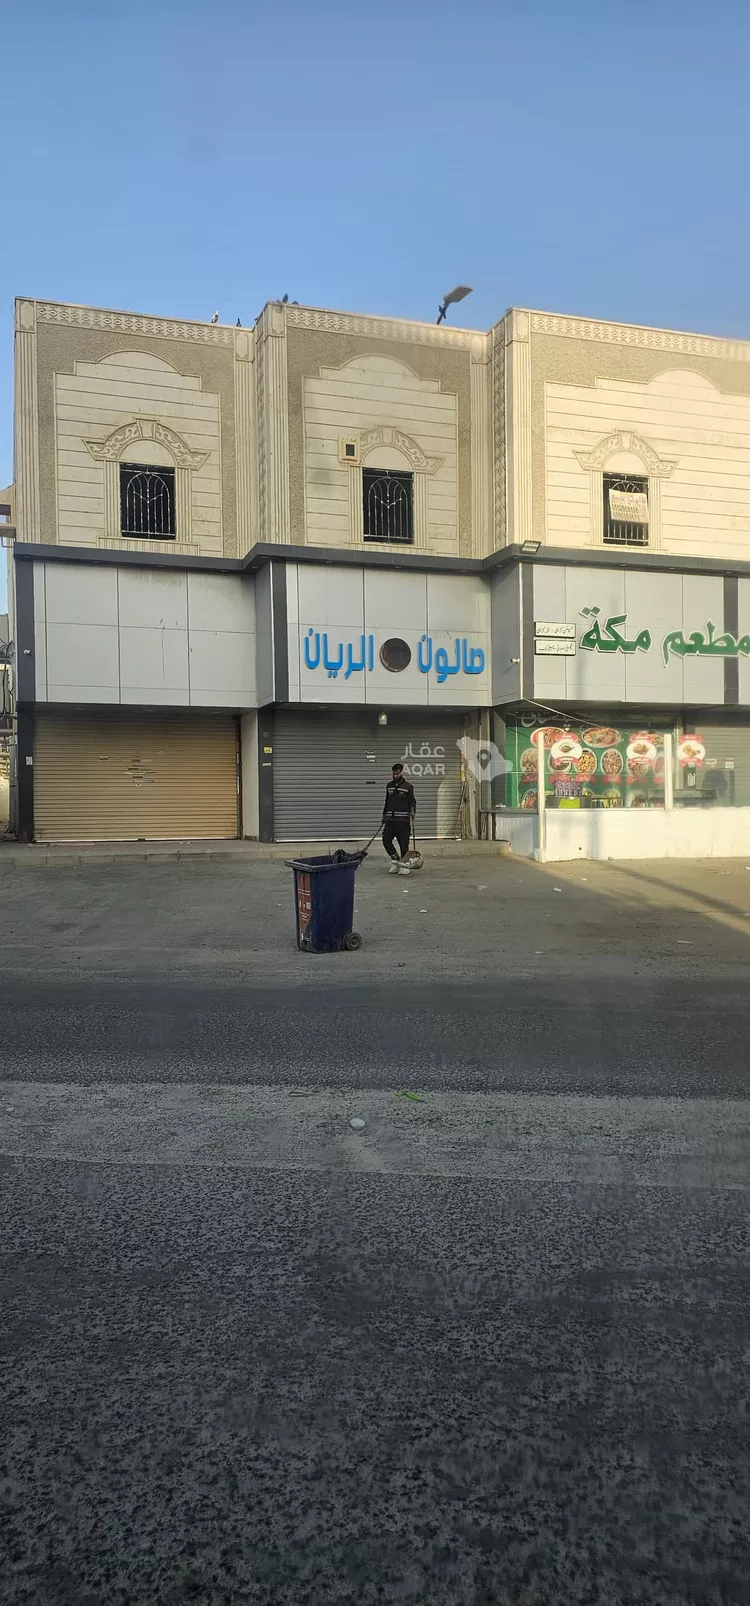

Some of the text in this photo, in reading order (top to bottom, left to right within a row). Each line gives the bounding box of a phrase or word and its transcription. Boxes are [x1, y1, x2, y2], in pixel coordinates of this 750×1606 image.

[304, 628, 485, 683] صالون الريان
[579, 606, 652, 654] مكة
